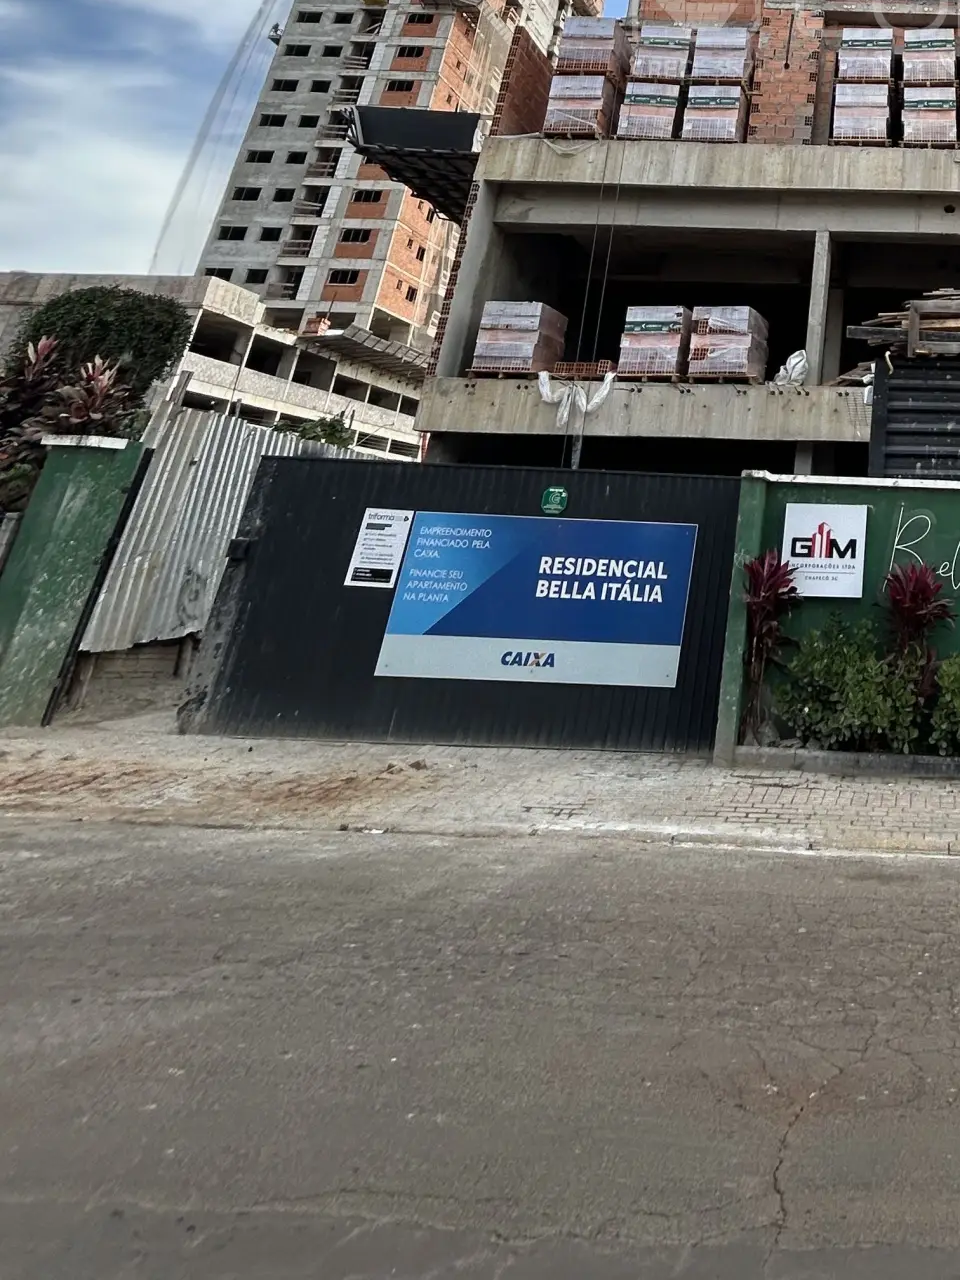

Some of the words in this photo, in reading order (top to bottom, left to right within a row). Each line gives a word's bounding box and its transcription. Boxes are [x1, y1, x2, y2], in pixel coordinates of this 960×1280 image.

[368, 512, 395, 522] triforma
[420, 526, 492, 538] EMPREENDIMENTO
[416, 538, 469, 549] FINANCIADO
[471, 539, 491, 549] PELA
[538, 556, 668, 580] RESIDENCIAL
[789, 562, 840, 570] NCORPORAÇÕES
[409, 568, 447, 579] FINANCIE
[448, 570, 464, 579] SEU
[405, 580, 468, 592] APARTAMENTO
[535, 579, 596, 601] BELLA
[600, 579, 663, 604] ITÁLIA
[402, 592, 416, 601] NA
[417, 592, 449, 602] PLANTA
[500, 650, 555, 669] CAIXA
